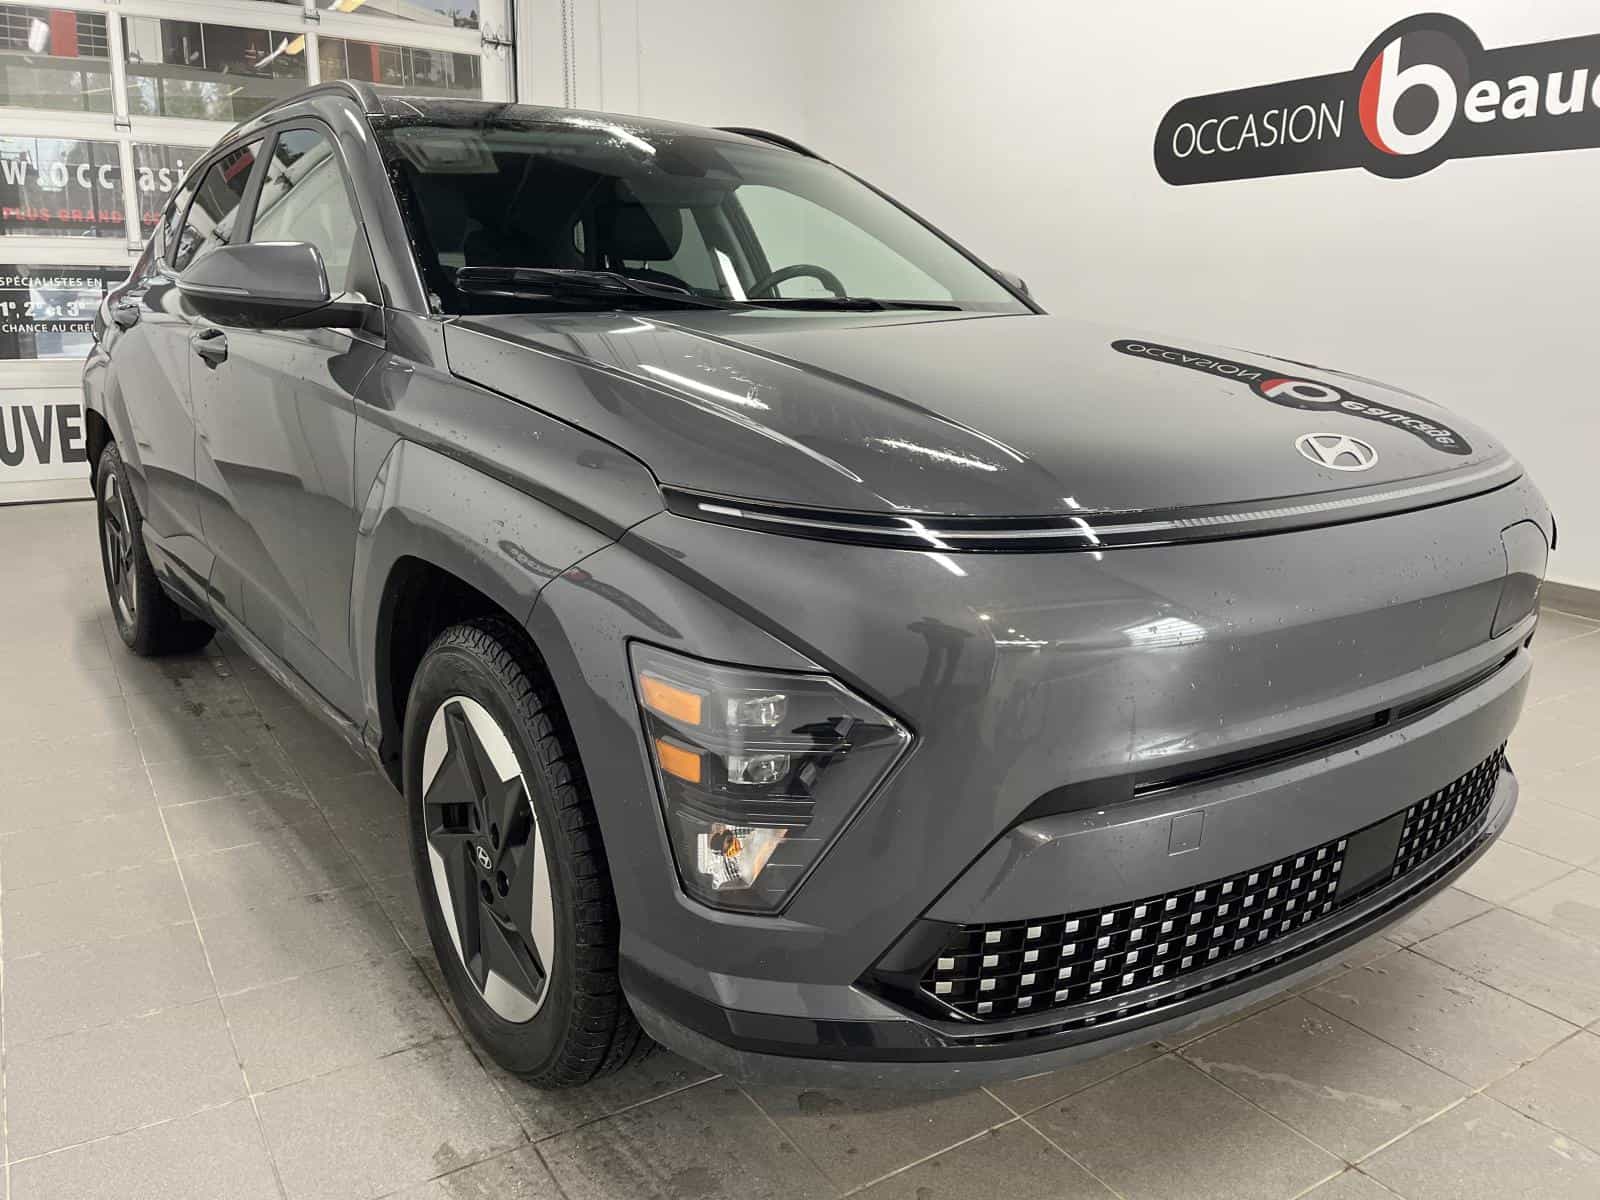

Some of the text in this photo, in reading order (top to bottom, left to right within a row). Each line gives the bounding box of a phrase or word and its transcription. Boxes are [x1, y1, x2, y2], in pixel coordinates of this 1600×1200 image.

[1172, 36, 1600, 158] OCCASION beau
[2, 207, 49, 221] PLUS
[0, 276, 102, 287] SPÉCIALISTES EN
[2, 323, 94, 333] CHANCE AU CRÉ
